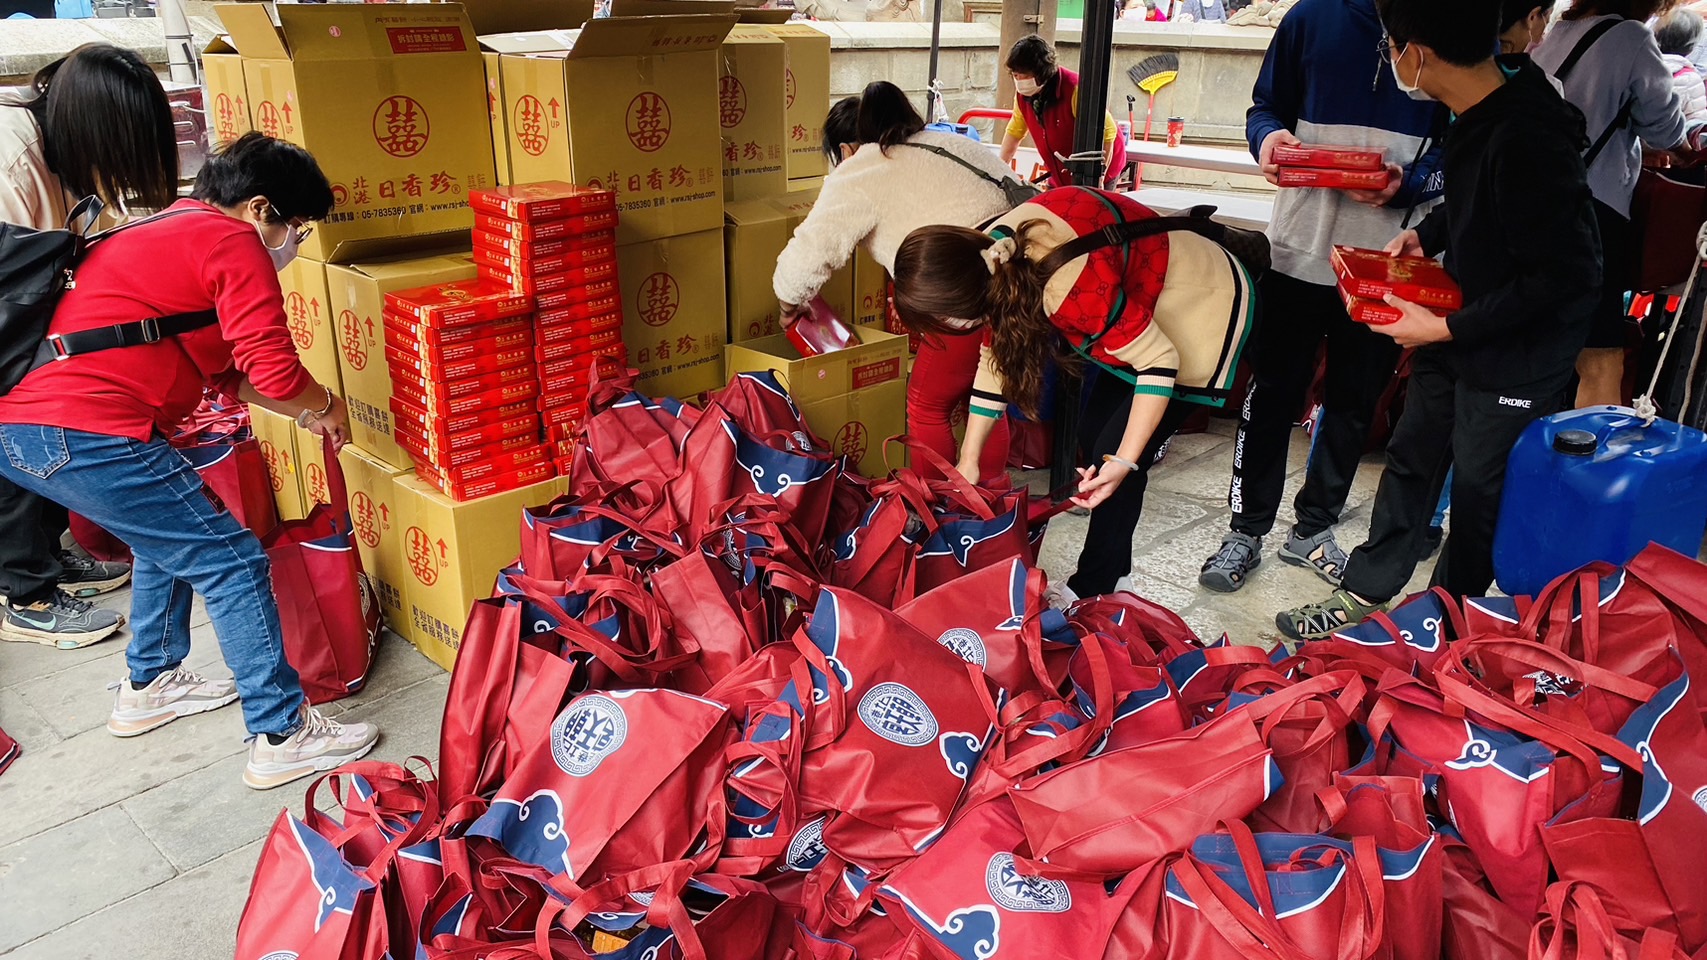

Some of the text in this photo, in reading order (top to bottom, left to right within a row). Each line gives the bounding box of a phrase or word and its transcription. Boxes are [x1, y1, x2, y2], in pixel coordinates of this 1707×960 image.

[550, 120, 561, 129] UP
[378, 170, 457, 199] 日香珍
[627, 164, 691, 192] 日香珍
[352, 175, 372, 205] 北港
[368, 338, 376, 348] UP
[1498, 396, 1532, 409] ERDIKE
[1234, 428, 1246, 469] ERDIKE
[1231, 475, 1243, 513] ERDIKE
[381, 521, 391, 530] UP
[439, 558, 449, 569] UP
